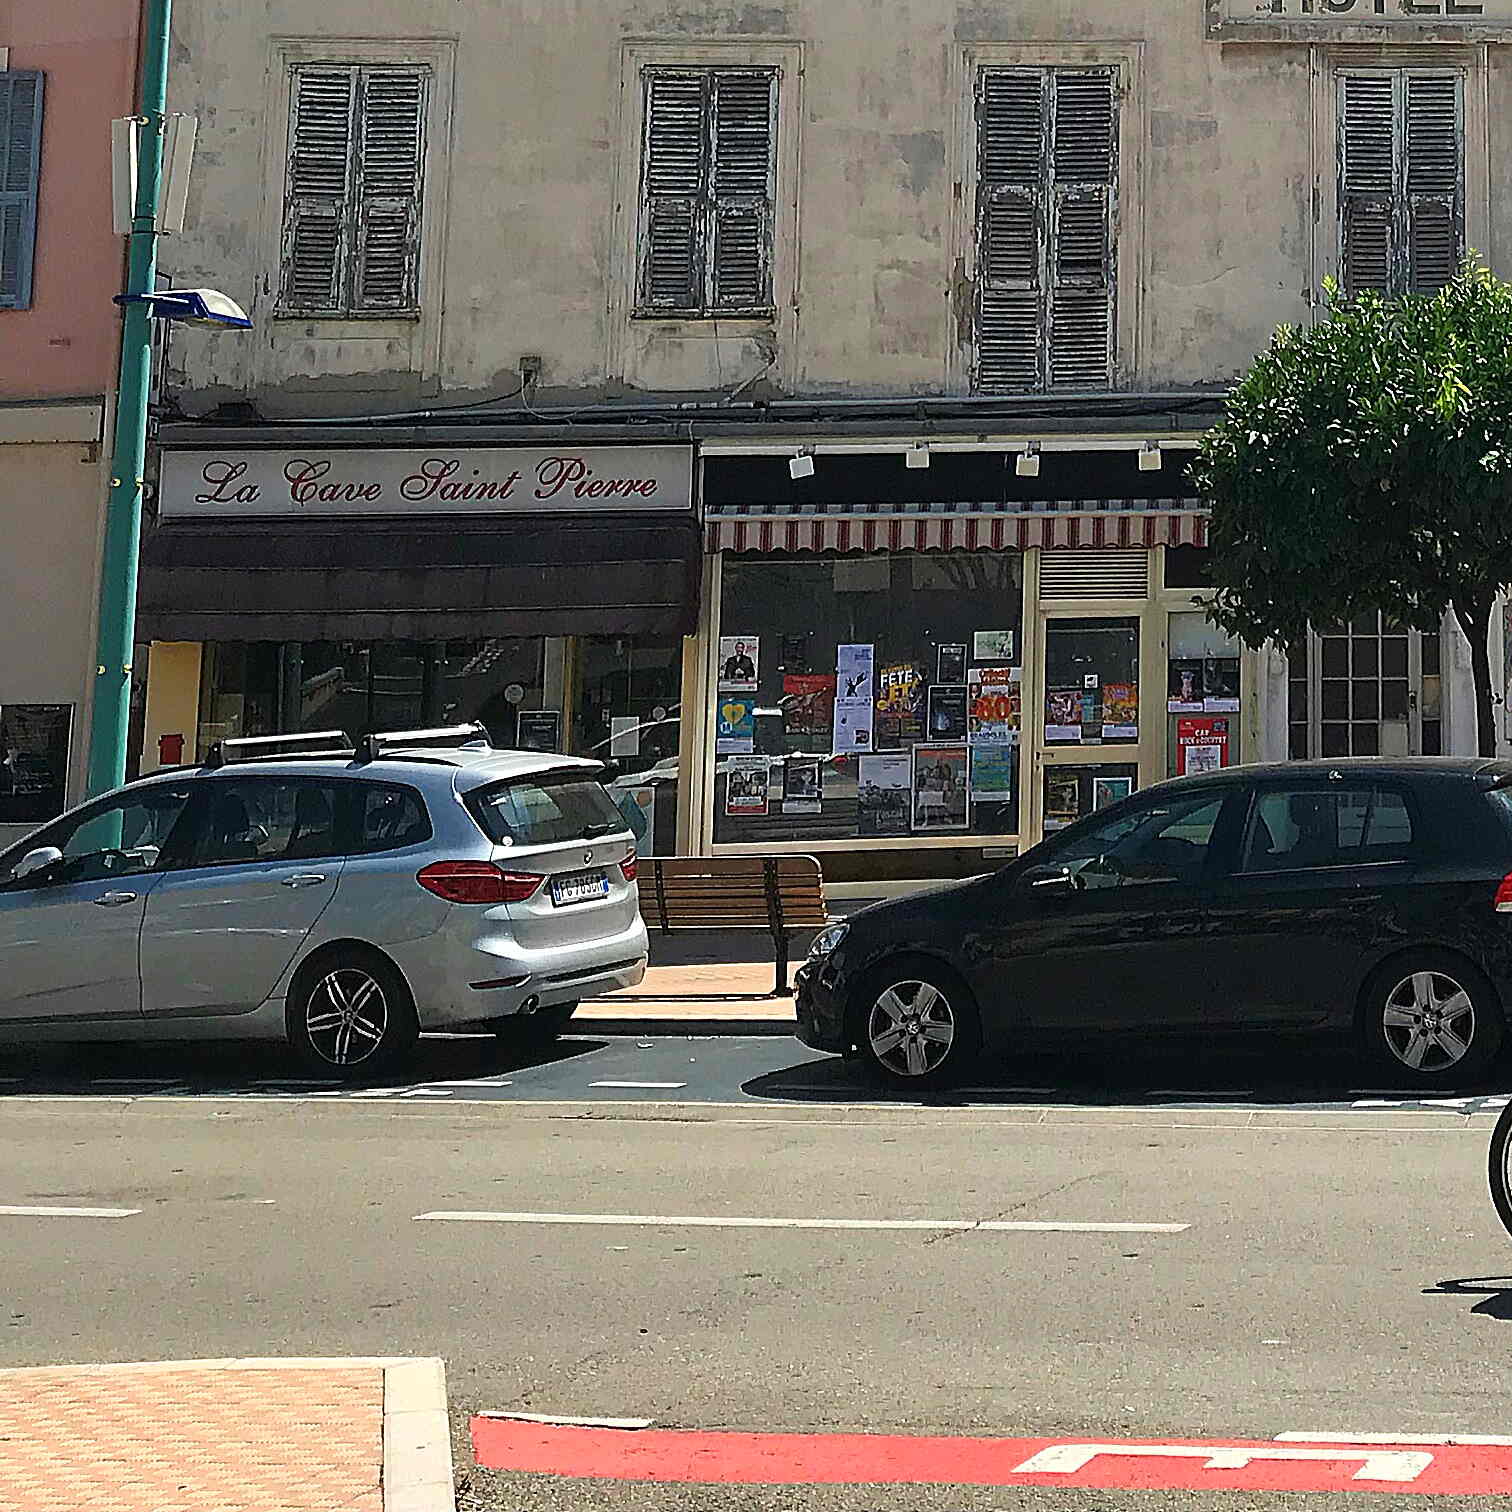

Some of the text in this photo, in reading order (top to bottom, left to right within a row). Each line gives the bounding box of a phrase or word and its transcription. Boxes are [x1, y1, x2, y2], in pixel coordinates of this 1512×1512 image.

[195, 456, 657, 506] La Cave Saint Pierre
